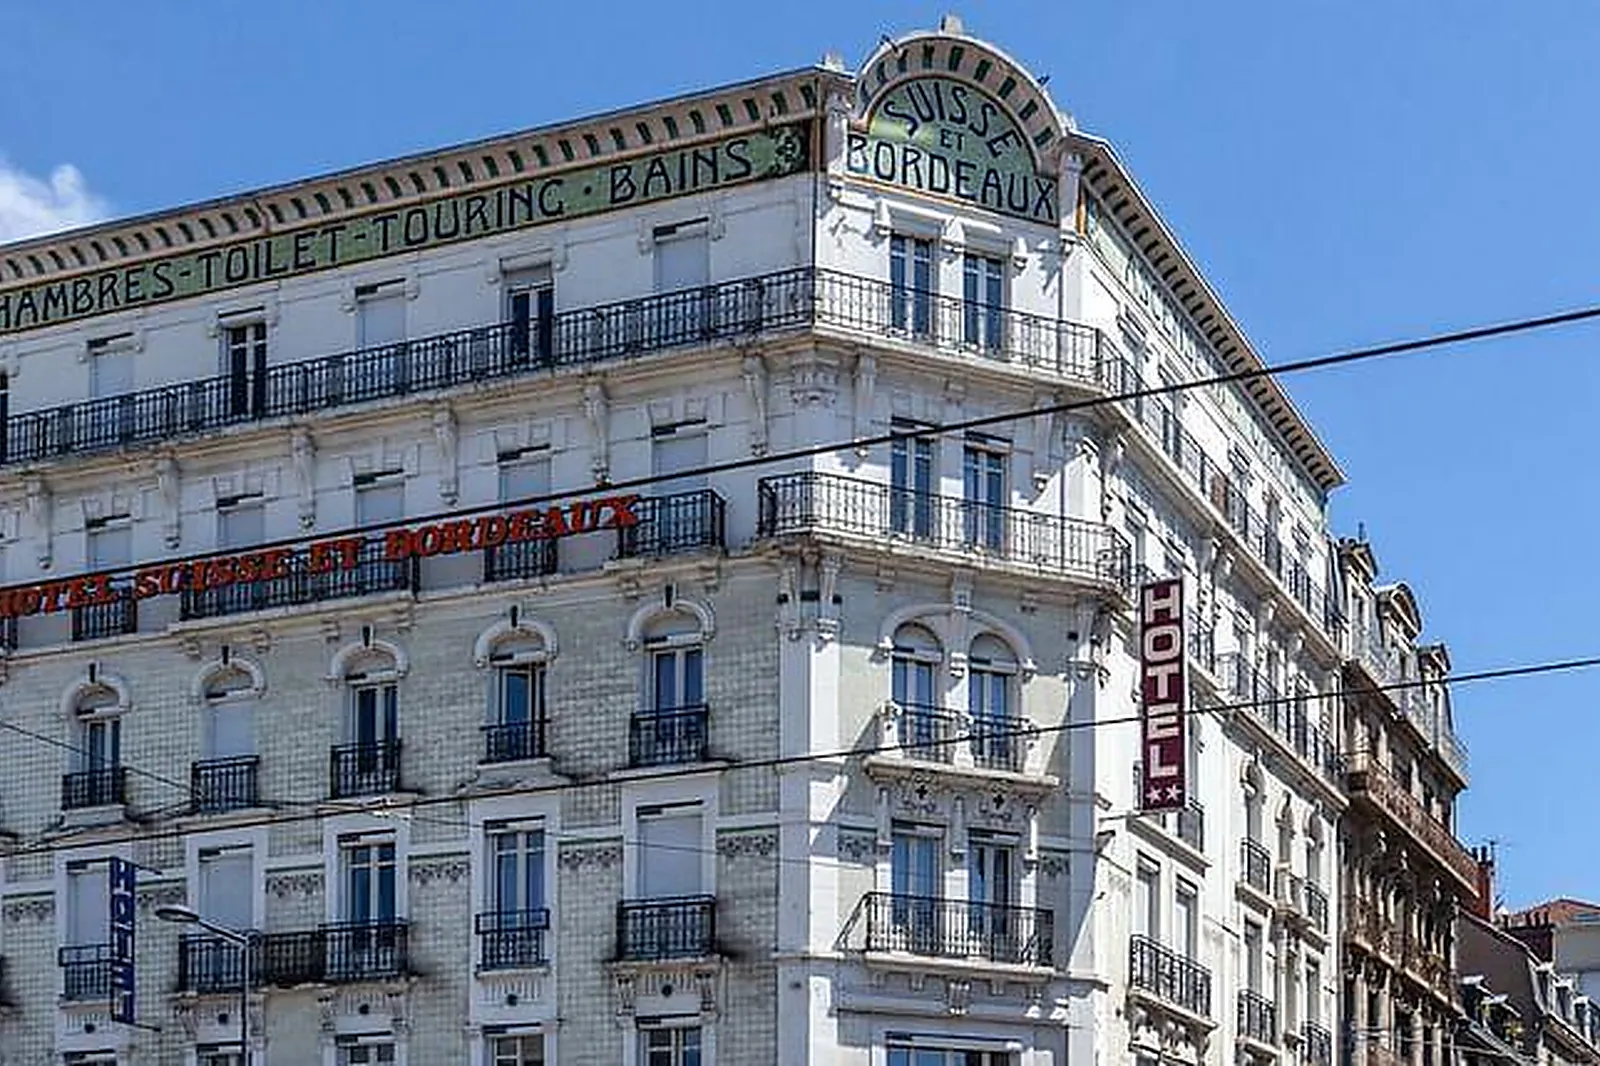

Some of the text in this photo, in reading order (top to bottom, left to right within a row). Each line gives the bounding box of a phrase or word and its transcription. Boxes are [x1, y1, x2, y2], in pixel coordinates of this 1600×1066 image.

[883, 81, 1022, 158] SUISSE
[940, 128, 965, 151] ET
[610, 138, 752, 202] BAINS
[848, 134, 1055, 220] BORDEAUX
[135, 548, 294, 599] SUISSE
[309, 536, 364, 574] ET
[385, 495, 641, 562] BORDEAUX
[1144, 584, 1181, 778] HOTEL
